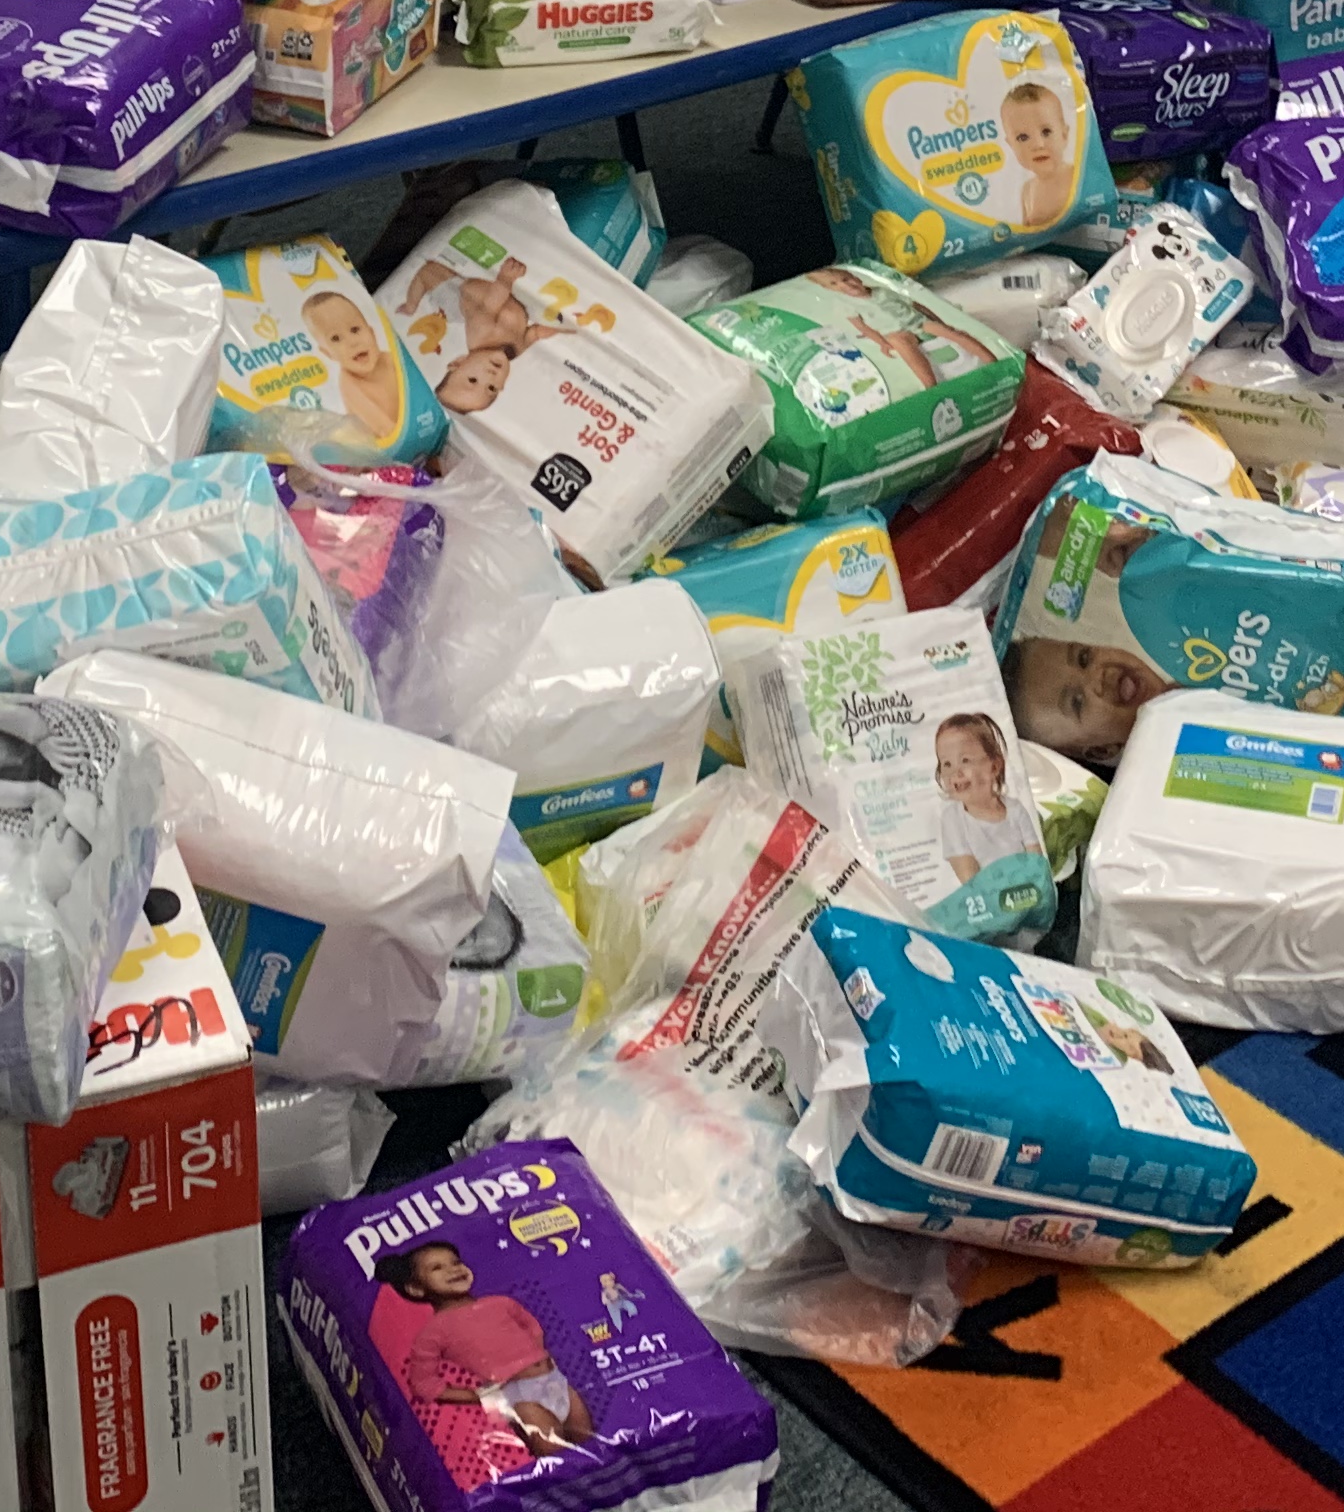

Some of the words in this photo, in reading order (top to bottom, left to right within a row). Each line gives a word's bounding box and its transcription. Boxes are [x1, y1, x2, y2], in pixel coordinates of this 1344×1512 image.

[537, 0, 654, 30] HUGGIES
[553, 27, 603, 41] natural
[605, 25, 636, 38] care
[1156, 63, 1230, 105] Sleep
[907, 118, 999, 159] Pampers
[925, 151, 1002, 181] swaddlers
[902, 236, 919, 256] 4
[944, 240, 964, 258] 22
[222, 329, 314, 378] Pampers
[253, 362, 326, 396] swaddlers
[559, 380, 618, 431] Gentle
[578, 424, 620, 463] Soft
[616, 422, 636, 444] &
[539, 463, 579, 501] 365
[838, 542, 872, 564] 2X
[841, 690, 913, 720] Nature's
[842, 711, 925, 746] Promise
[867, 729, 910, 763] Baby
[1225, 735, 1304, 757] Comfees
[540, 782, 616, 814] Comfees
[862, 798, 907, 816] Diapers
[965, 894, 986, 915] 23
[666, 981, 704, 1028] You
[181, 1120, 218, 1199] 704
[131, 1183, 156, 1212] 11
[343, 1170, 531, 1281] Pull-Ups
[89, 1316, 111, 1367] FREE
[589, 1332, 669, 1371] 3T-4T
[90, 1370, 122, 1500] FRAGRANCE
